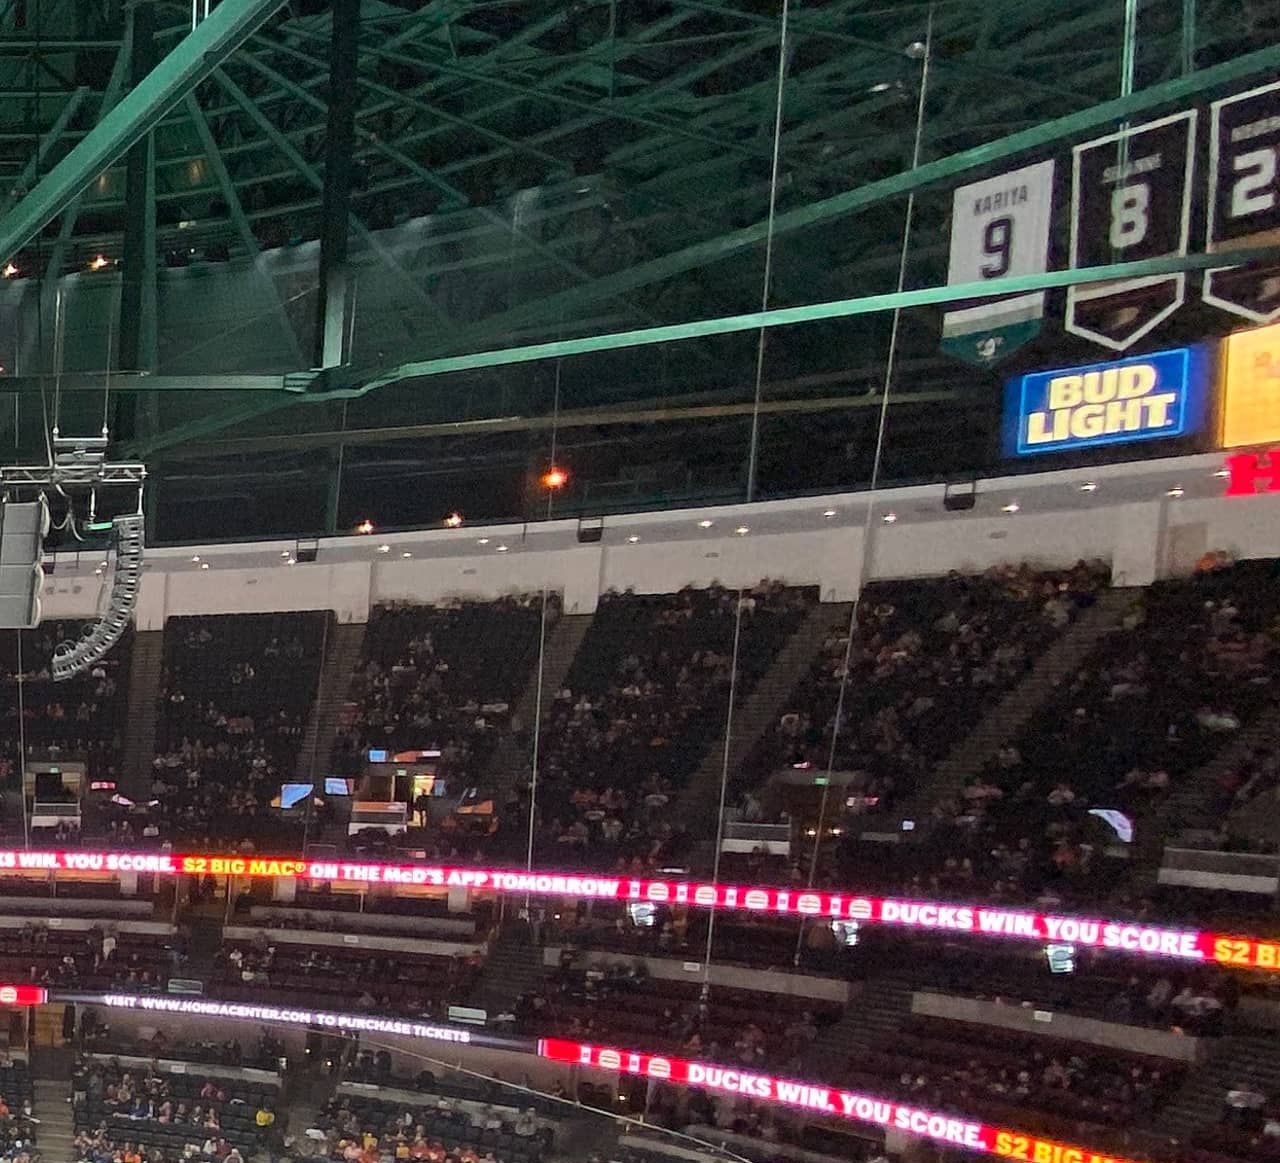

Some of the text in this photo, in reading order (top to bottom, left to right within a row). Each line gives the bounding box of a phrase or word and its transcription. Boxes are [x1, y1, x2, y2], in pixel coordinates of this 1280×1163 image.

[974, 185, 1028, 215] KARIYA
[1109, 182, 1151, 248] 8
[981, 216, 1015, 278] 9
[1049, 364, 1156, 410] BUD
[1027, 393, 1176, 444] LIGHT
[20, 853, 60, 867] WIN.
[65, 854, 103, 870] YOU
[107, 855, 175, 872] SCORE.
[211, 859, 245, 875] BIG
[310, 864, 339, 879] ON
[343, 864, 379, 880] THE
[383, 866, 443, 884] McD'S
[447, 870, 488, 886] APP
[492, 872, 618, 896] TOMORROW
[881, 901, 1204, 958] DUCKS WIN. YOU SCORE.
[105, 995, 136, 1008] VISIT
[317, 1013, 335, 1026] TO
[338, 1016, 410, 1035] PURCHASE
[413, 1023, 470, 1042] TICKETS
[687, 1062, 772, 1098] DUCKS
[776, 1081, 834, 1112] WIN.
[841, 1094, 891, 1125] YOU
[895, 1107, 986, 1149] SCORE.
